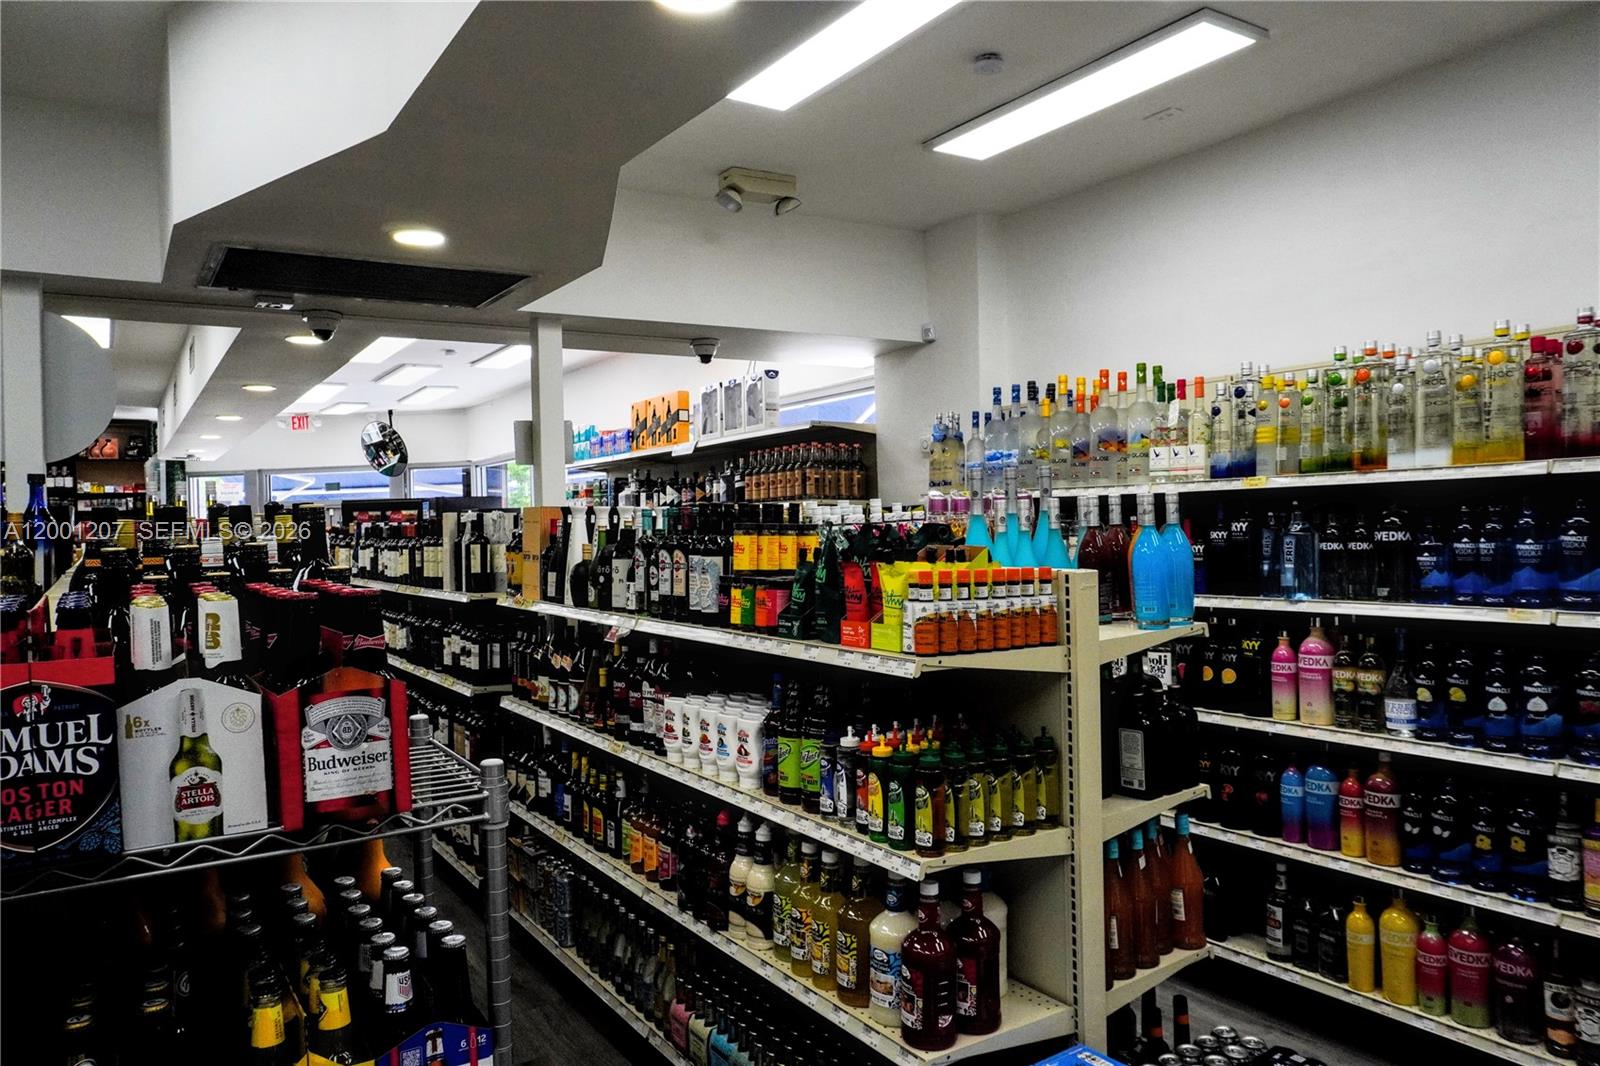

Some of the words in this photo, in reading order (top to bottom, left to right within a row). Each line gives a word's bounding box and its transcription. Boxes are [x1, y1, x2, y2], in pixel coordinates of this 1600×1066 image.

[291, 415, 309, 430] EXIT
[1285, 540, 1294, 562] FRIS
[307, 750, 388, 773] Budweiser
[181, 787, 214, 798] STELLA
[181, 795, 215, 806] ARTOIS
[0, 799, 72, 823] AGER
[48, 816, 78, 825] COMPLEX
[460, 1039, 467, 1048] 6
[477, 1034, 487, 1043] 12
